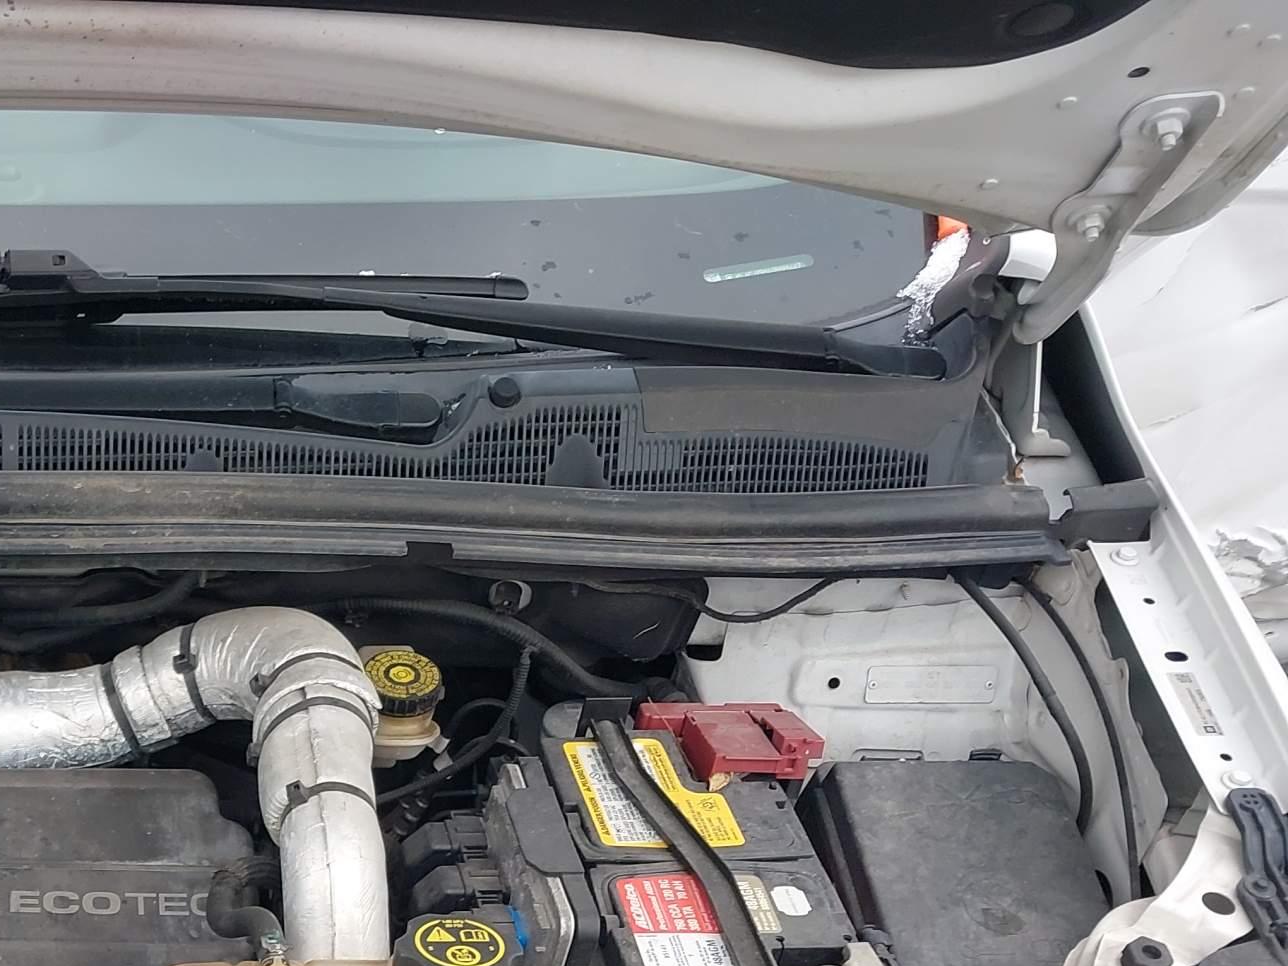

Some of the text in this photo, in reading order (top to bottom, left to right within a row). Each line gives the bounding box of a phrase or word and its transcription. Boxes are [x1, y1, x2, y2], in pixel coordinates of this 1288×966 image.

[657, 879, 671, 890] RC
[671, 880, 686, 892] AH
[661, 889, 675, 901] 120
[676, 891, 689, 900] 70
[624, 882, 650, 930] ACDelco
[667, 903, 682, 919] CCA
[682, 905, 697, 920] LTA
